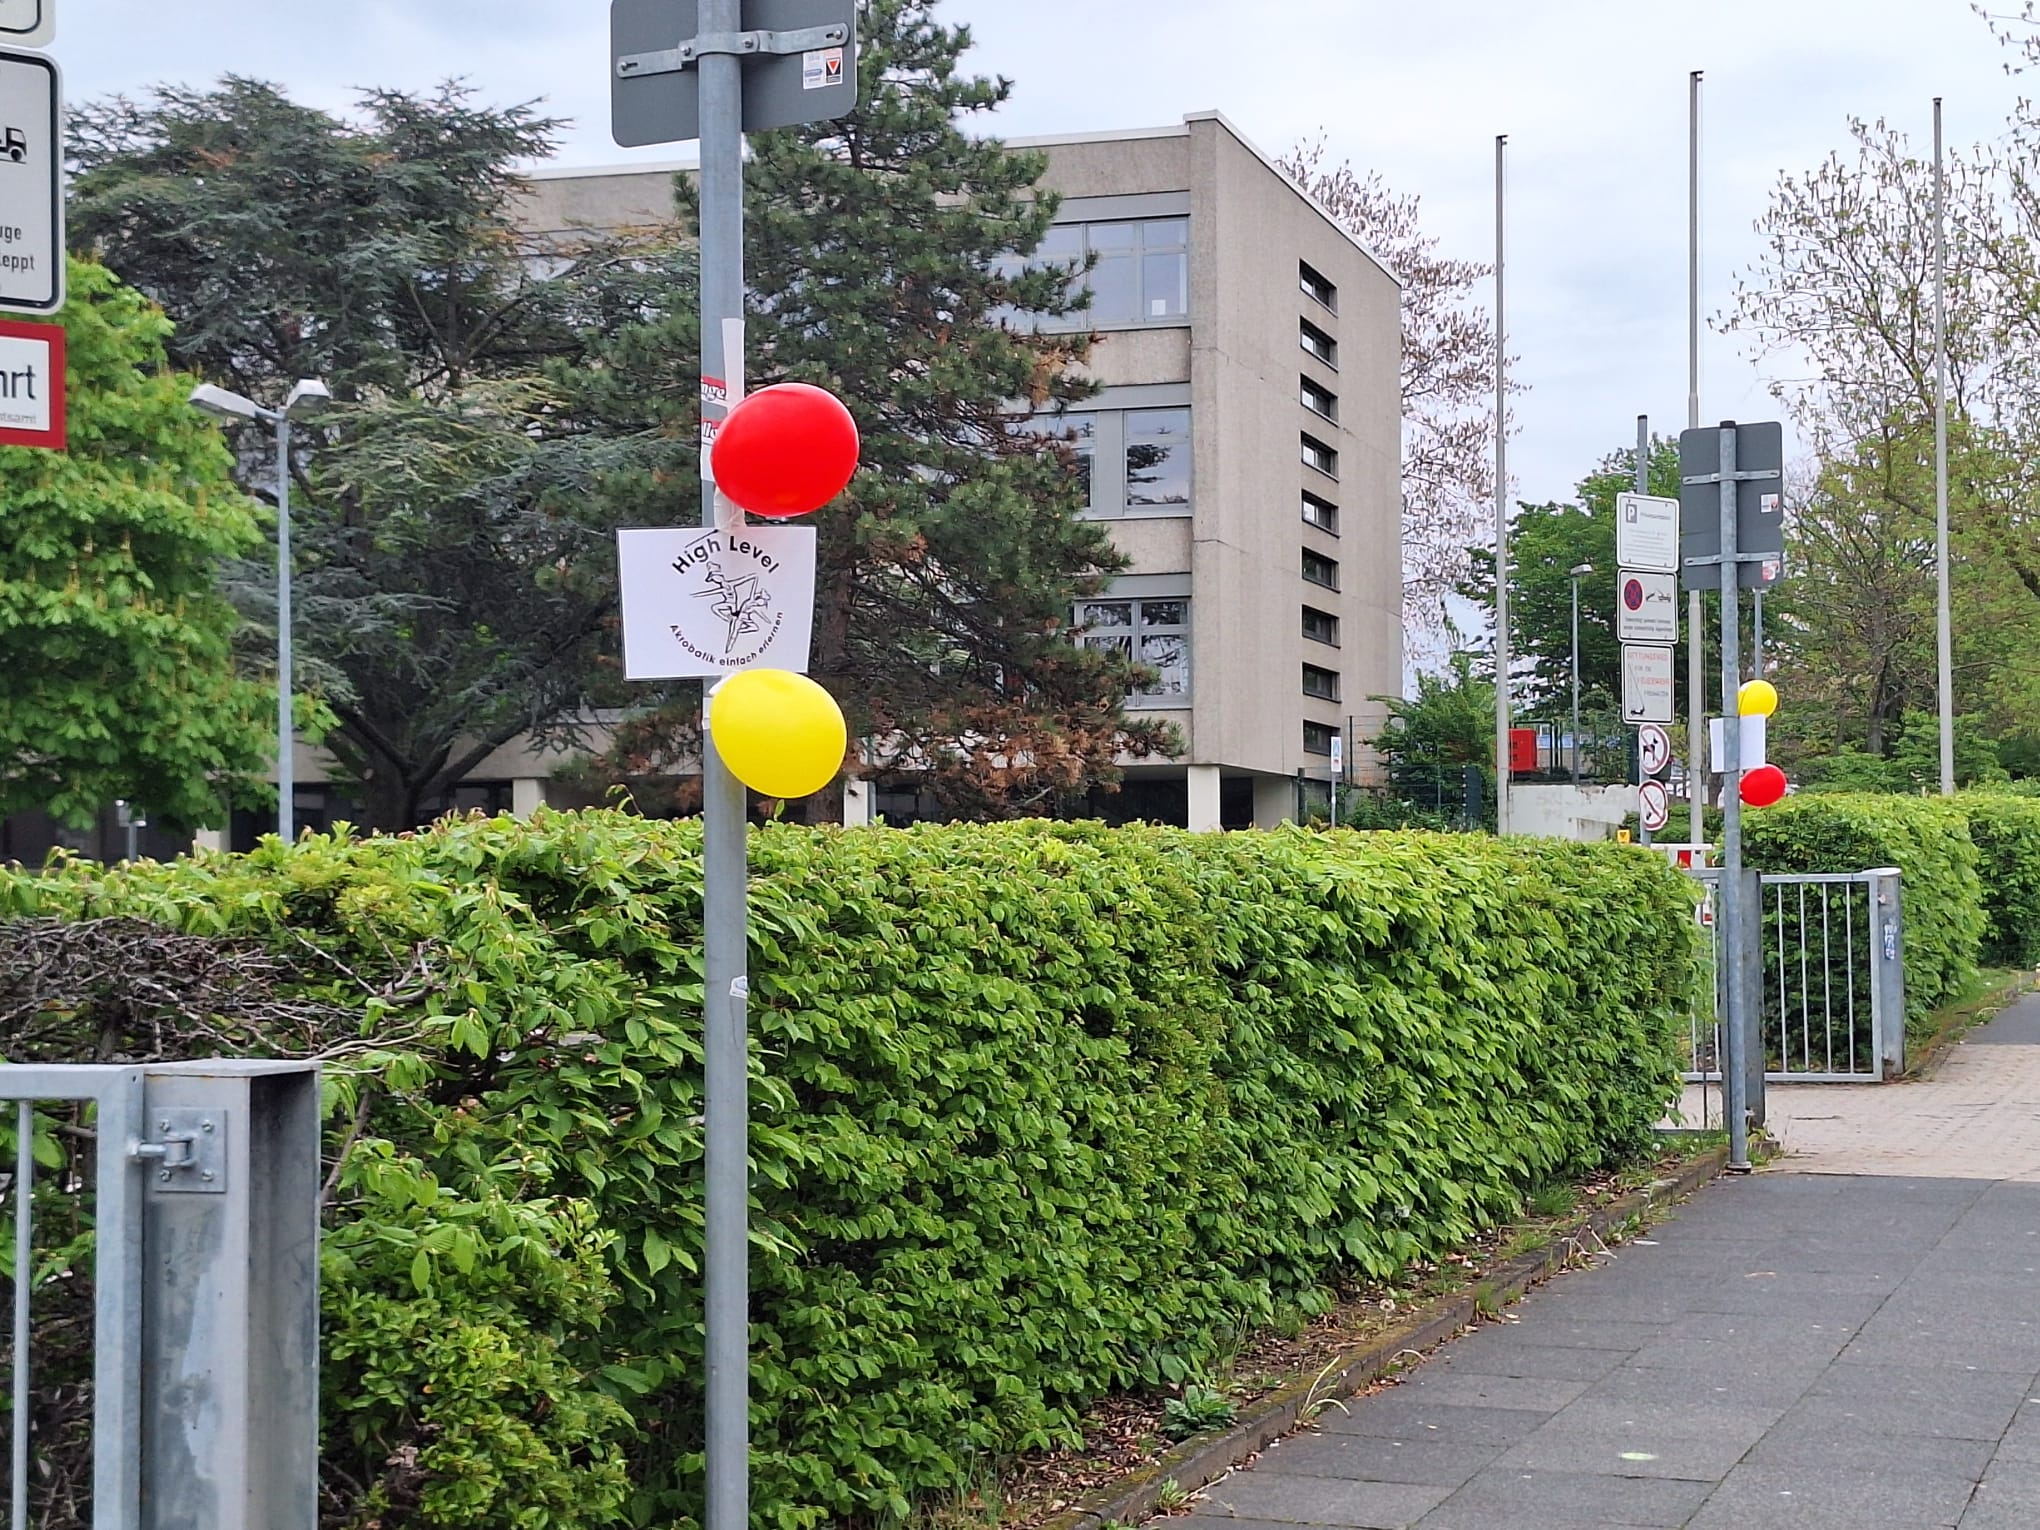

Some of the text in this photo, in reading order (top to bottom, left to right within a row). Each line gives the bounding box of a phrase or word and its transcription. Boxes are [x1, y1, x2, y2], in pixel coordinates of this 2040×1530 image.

[0, 226, 22, 244] ge
[0, 254, 35, 273] eppt
[672, 536, 779, 574] High Level
[670, 612, 783, 666] Akrobatik einfach erlernen
